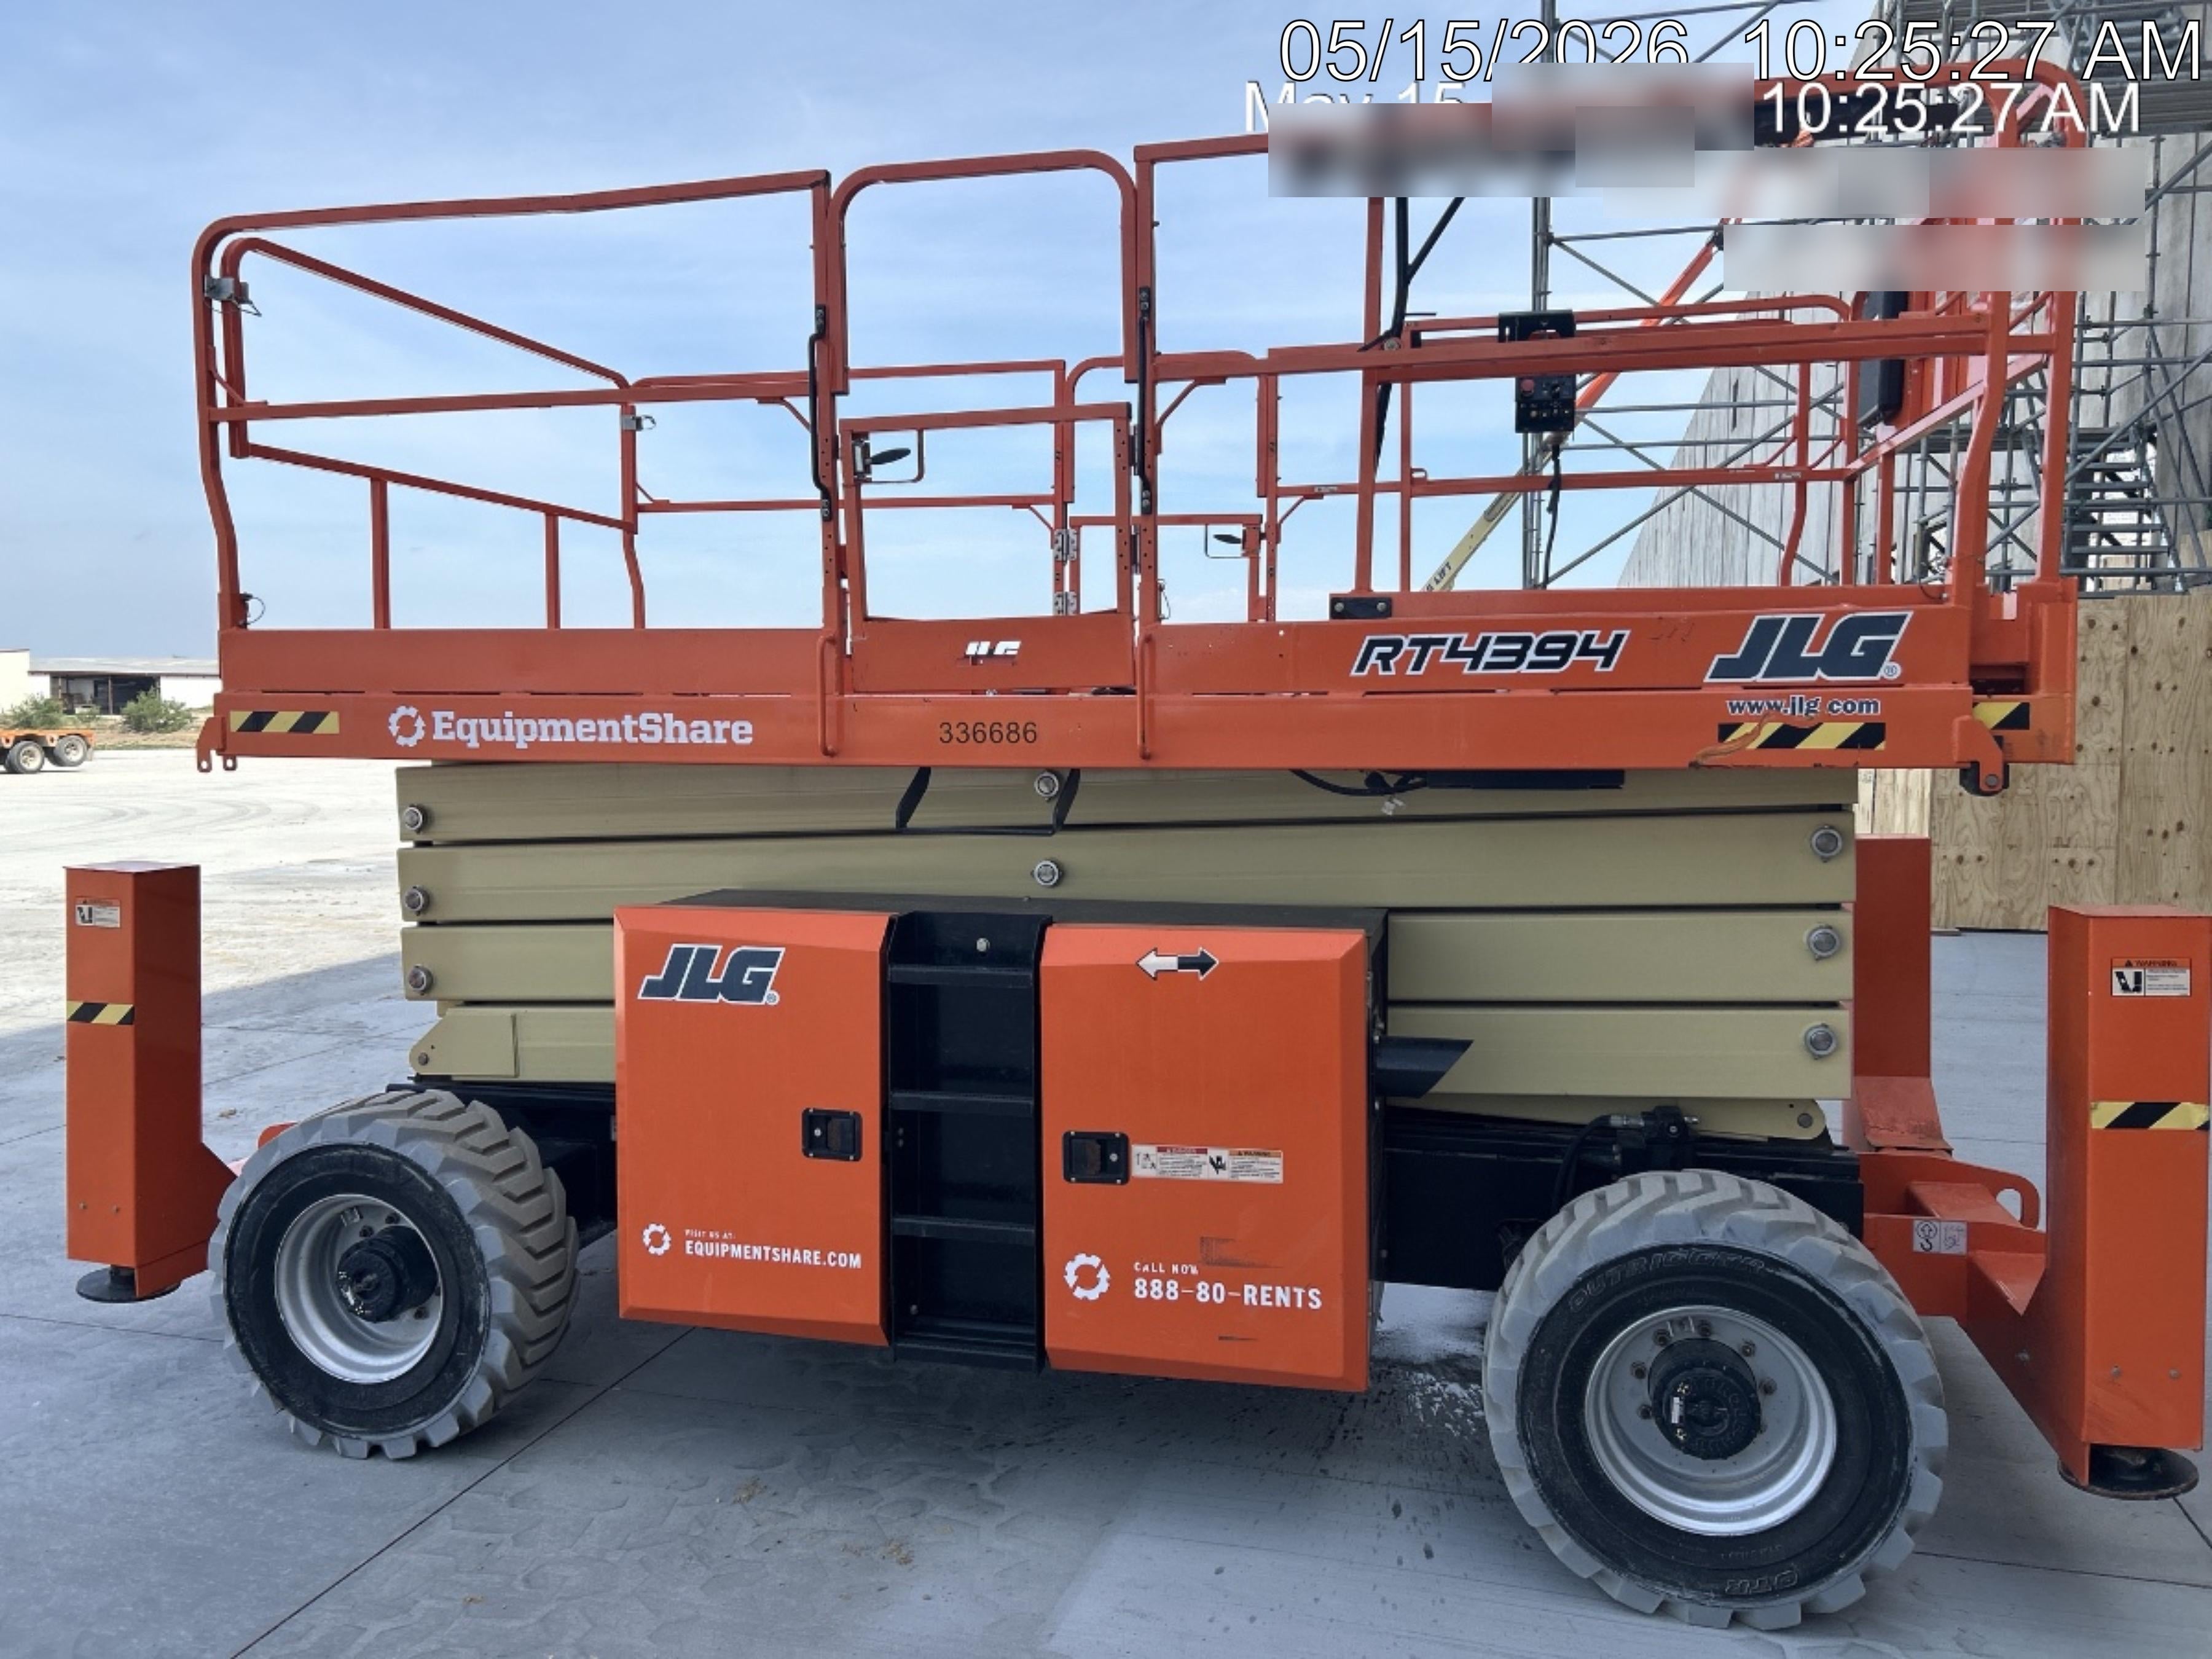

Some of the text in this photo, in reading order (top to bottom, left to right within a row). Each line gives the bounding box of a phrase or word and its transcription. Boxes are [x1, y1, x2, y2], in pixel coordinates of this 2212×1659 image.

[1350, 630, 1631, 676] RT4394
[432, 710, 754, 751] EquipmentShare
[938, 721, 1038, 745] 336686
[684, 1240, 861, 1269] EQUIPMENTSHARE.COM
[1134, 1261, 1166, 1274] CALL
[1135, 1278, 1322, 1309] 888-80-RENTS
